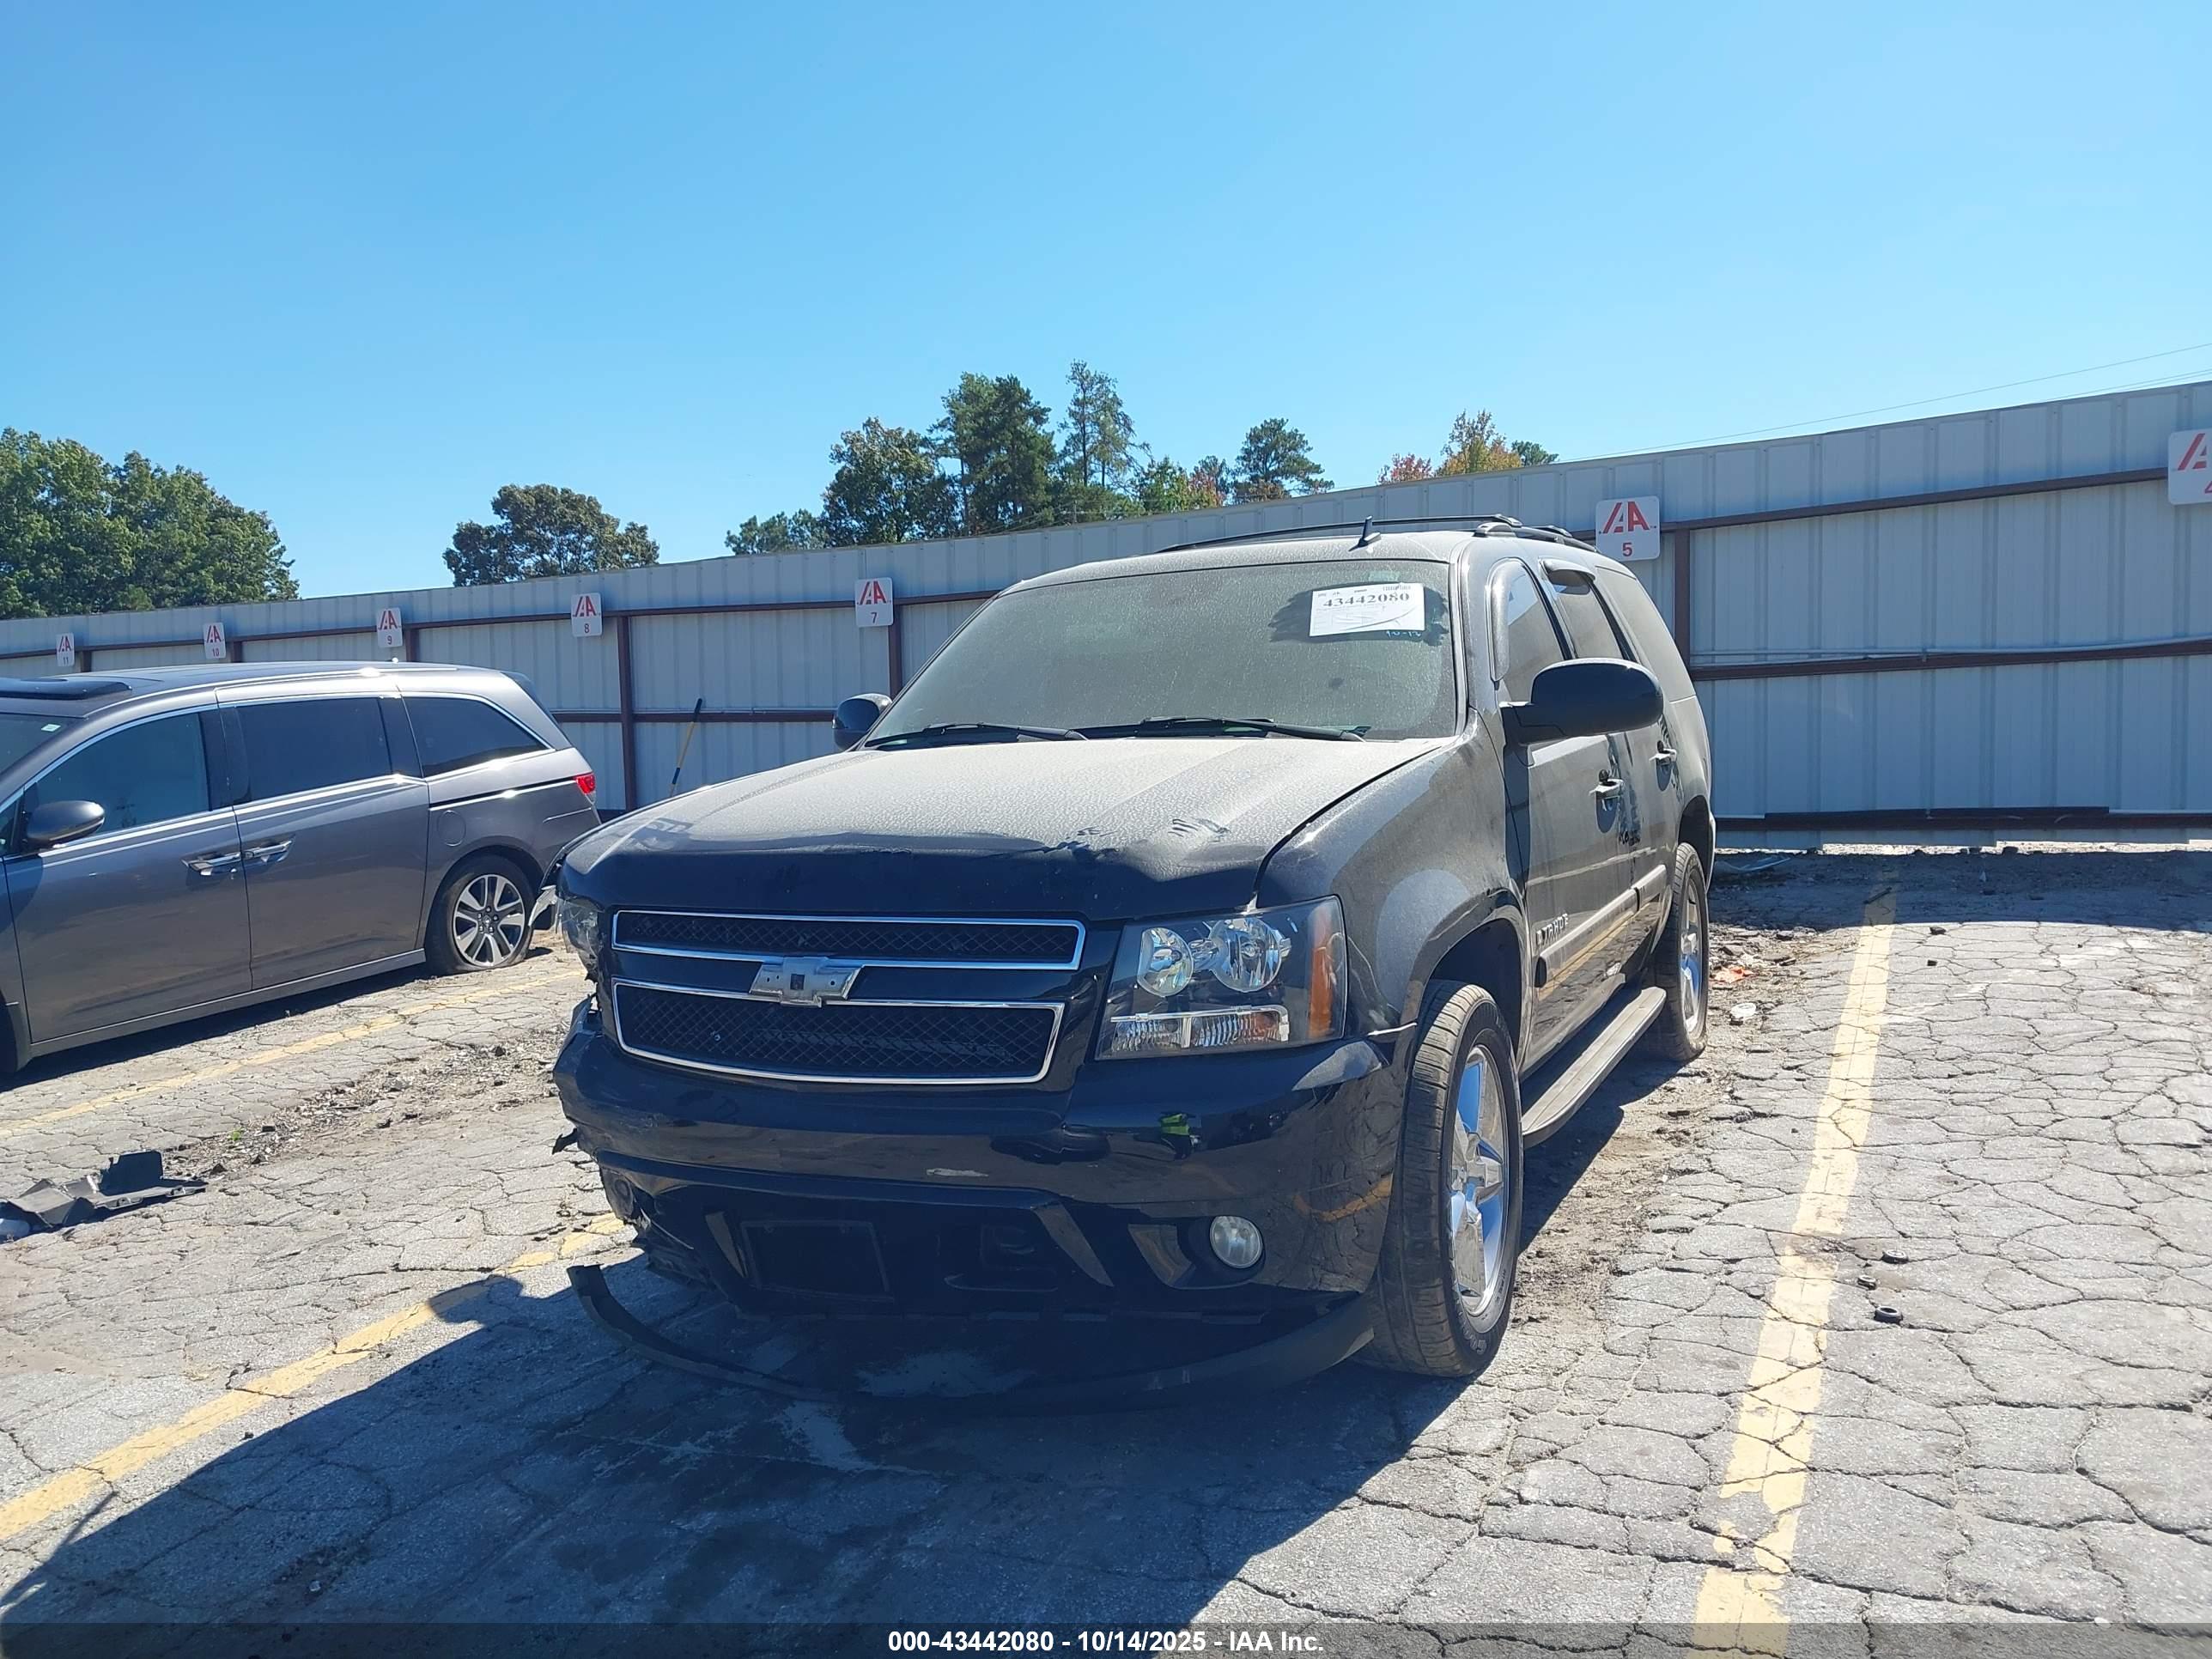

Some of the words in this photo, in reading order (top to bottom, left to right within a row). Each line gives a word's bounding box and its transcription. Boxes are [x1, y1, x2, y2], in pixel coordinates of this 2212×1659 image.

[1622, 542, 1633, 556] 5
[1322, 592, 1410, 606] 43442080
[871, 611, 878, 623] 7
[584, 623, 590, 634] 8
